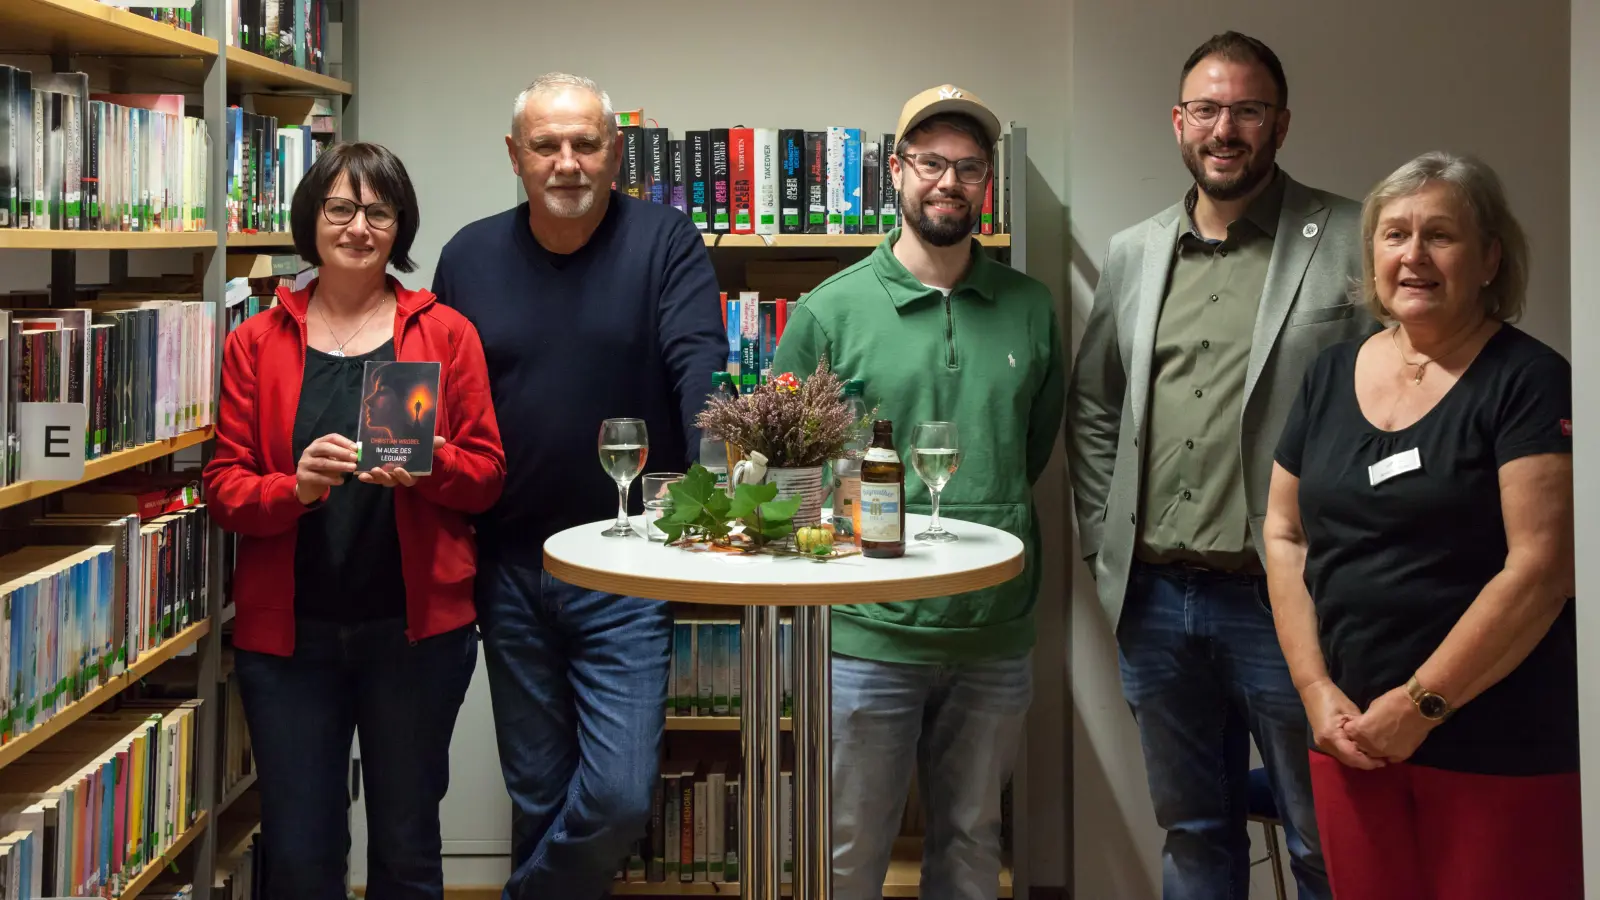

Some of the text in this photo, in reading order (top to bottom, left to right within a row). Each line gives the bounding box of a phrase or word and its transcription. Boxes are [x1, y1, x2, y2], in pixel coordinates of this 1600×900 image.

[628, 133, 636, 184] VERACHTUNG
[694, 151, 702, 178] OPFER
[735, 180, 743, 209] ADLER
[742, 179, 750, 209] OLSEN
[44, 425, 71, 458] E
[684, 787, 692, 824] MEMORIA
